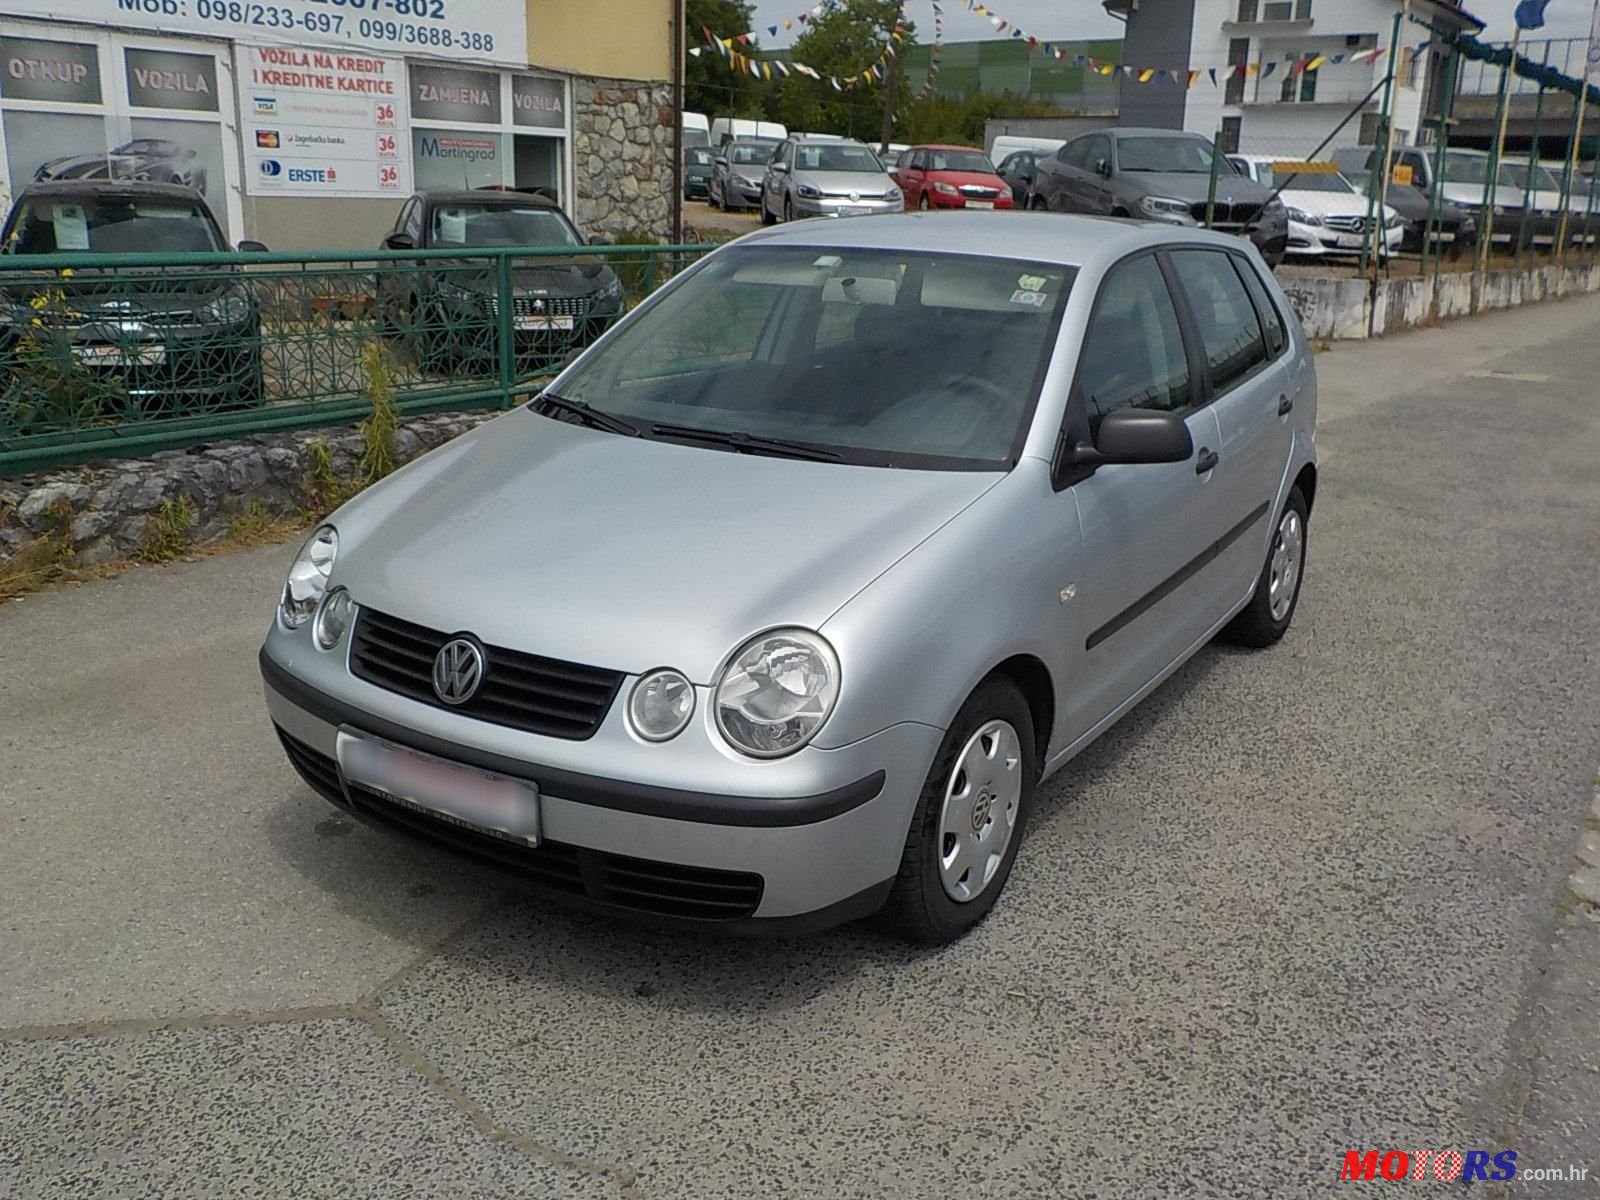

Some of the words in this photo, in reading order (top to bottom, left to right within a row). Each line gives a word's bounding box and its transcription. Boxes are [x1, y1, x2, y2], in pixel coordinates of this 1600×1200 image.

[197, 0, 351, 38] 098/233-697,
[359, 18, 494, 52] 099/3688-388
[8, 58, 88, 84] OTKUP
[258, 48, 310, 67] VOZILA
[313, 54, 333, 69] NA
[337, 56, 386, 74] KREDIT
[134, 68, 210, 94] VOZILA
[262, 70, 334, 90] KREDITNE
[337, 77, 394, 95] KARTICE
[419, 84, 491, 107] ZAMJENA
[514, 93, 562, 112] VOZILA
[377, 104, 394, 120] 36
[379, 136, 395, 151] 36
[421, 137, 496, 162] Martingrad
[288, 169, 325, 183] ERSTE
[381, 167, 397, 182] 36
